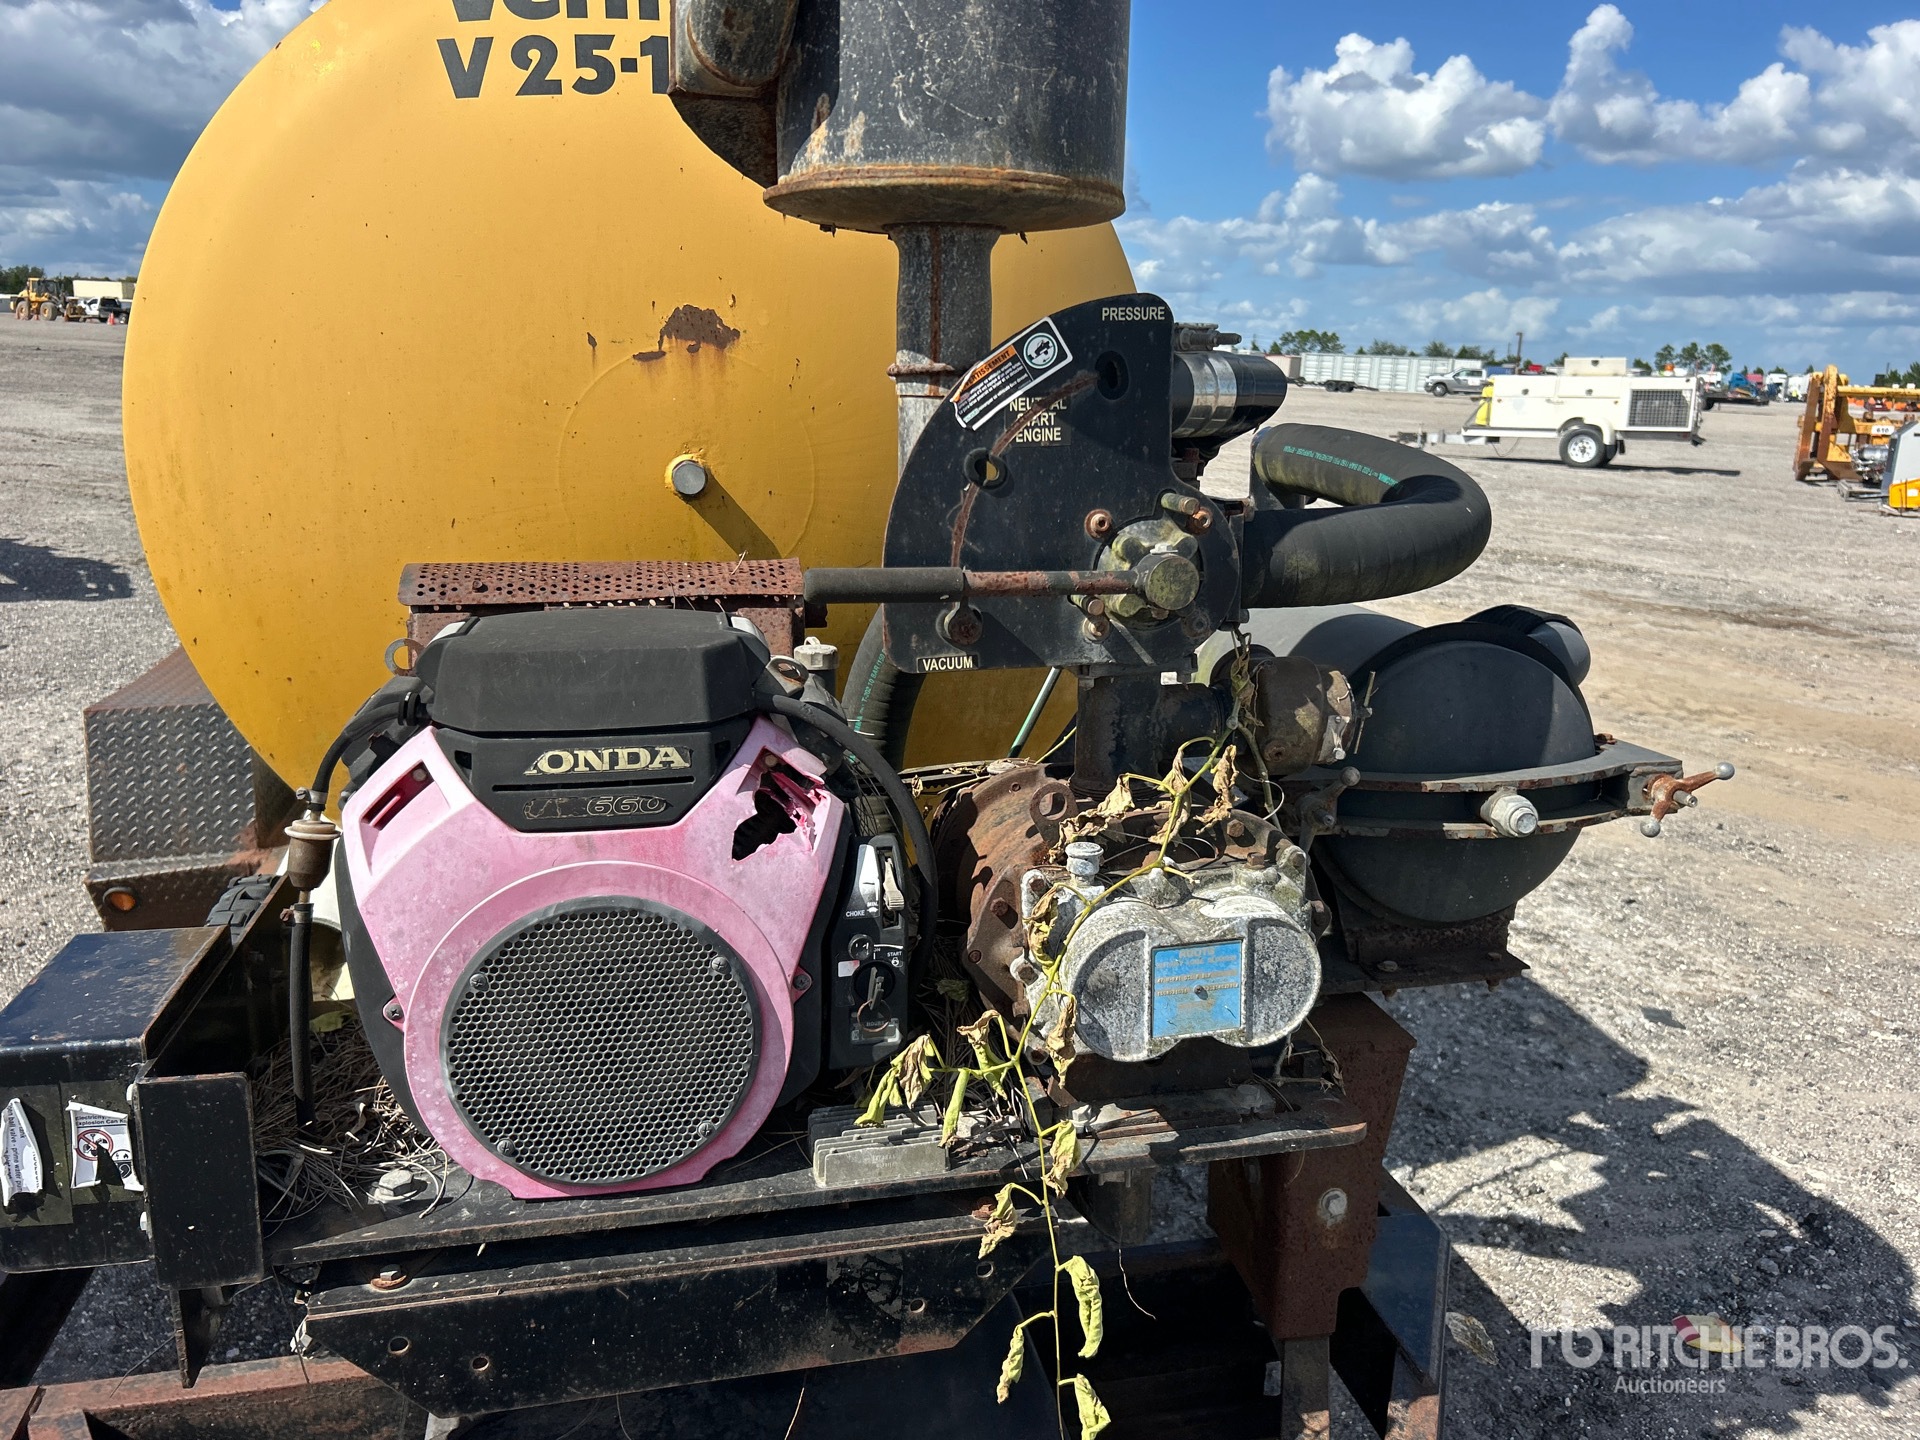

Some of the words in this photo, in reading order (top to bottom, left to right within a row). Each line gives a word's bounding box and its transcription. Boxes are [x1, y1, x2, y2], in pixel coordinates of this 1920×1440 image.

[437, 37, 494, 99] V
[1102, 306, 1165, 321] PRESSURE
[965, 350, 1010, 388] ERTISSEMENT
[1009, 397, 1067, 411] NEUAL
[1017, 412, 1056, 426] ART
[1015, 427, 1061, 442] ENGINE
[922, 656, 973, 671] VACUUM
[523, 746, 691, 776] ONDA
[586, 795, 667, 816] 660
[845, 909, 865, 917] CHOKE
